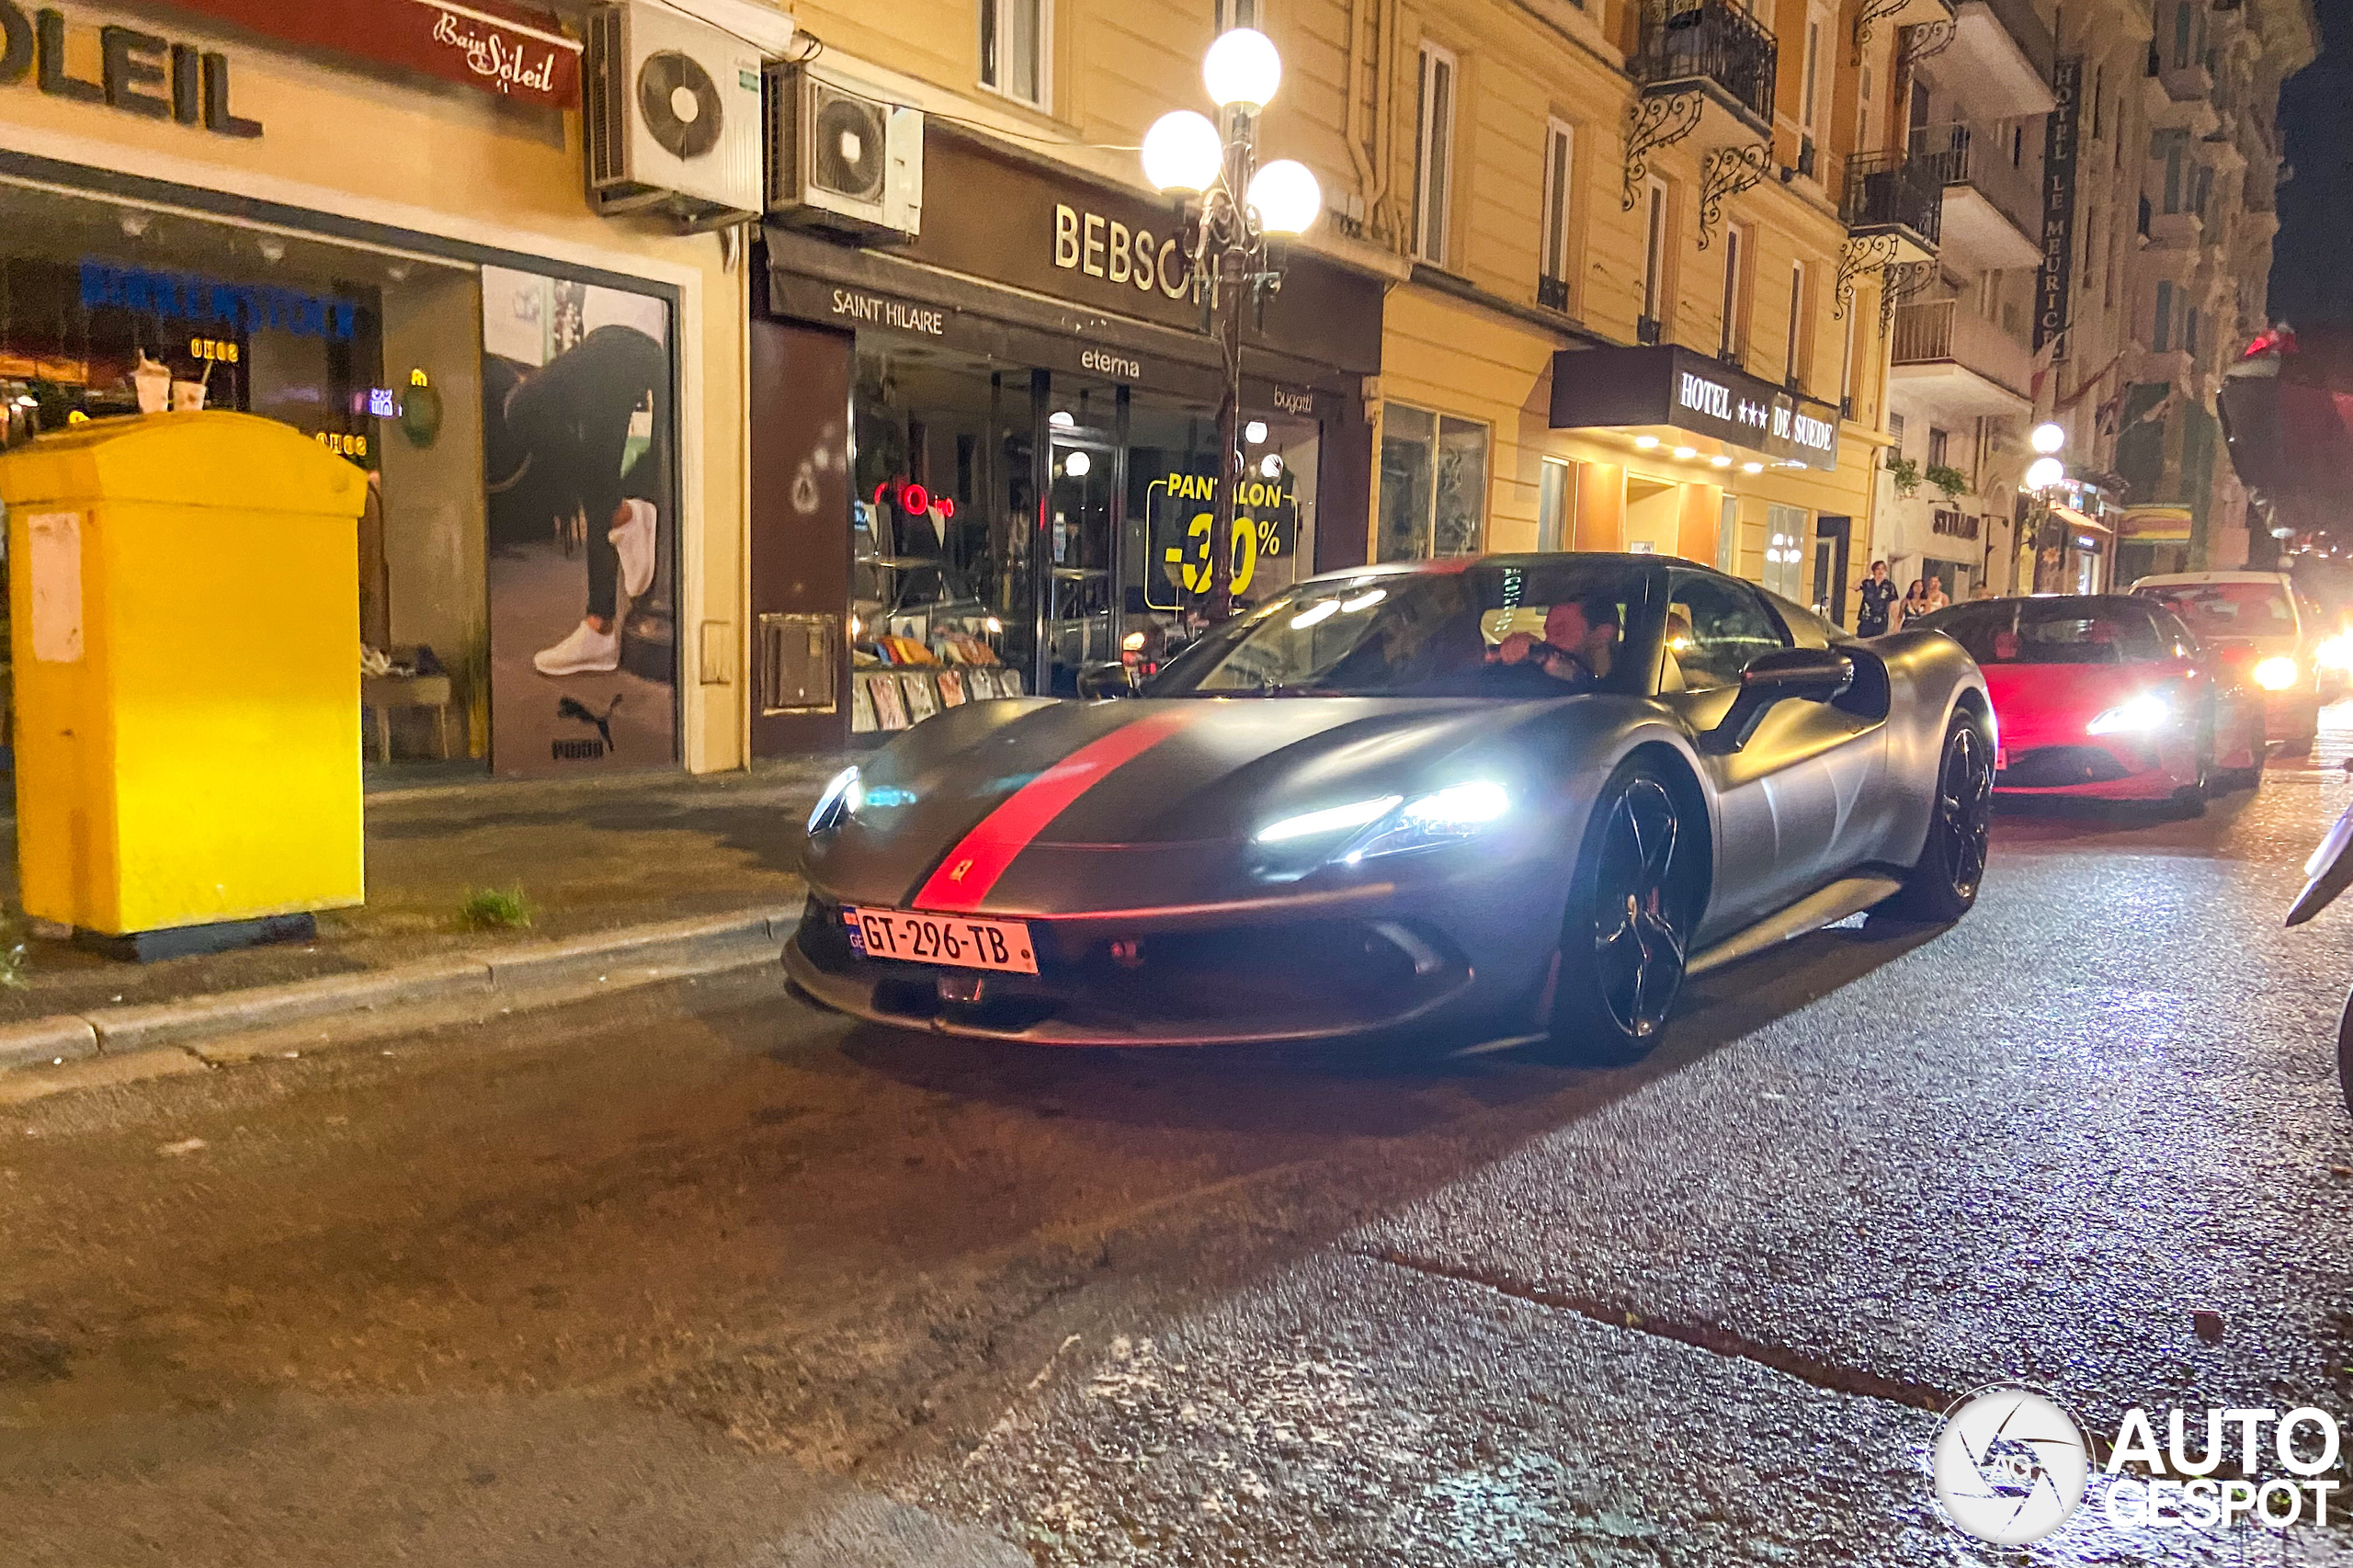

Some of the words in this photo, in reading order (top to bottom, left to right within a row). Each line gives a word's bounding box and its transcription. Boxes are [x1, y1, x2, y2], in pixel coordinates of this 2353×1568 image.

[434, 12, 485, 54] Bain
[467, 34, 554, 93] Soleil
[2055, 67, 2073, 159] HOTEL
[2052, 176, 2064, 210] LE
[833, 289, 882, 323] SAINT
[886, 302, 943, 335] HILAIRE
[1082, 347, 1140, 380] eterna
[1274, 384, 1313, 415] bugatti
[1680, 371, 1732, 421] HOTEL
[1772, 406, 1790, 439] DE
[1794, 414, 1833, 451] SUEDE
[1167, 472, 1281, 508] PANLON
[862, 915, 1009, 963] GT-296-TB
